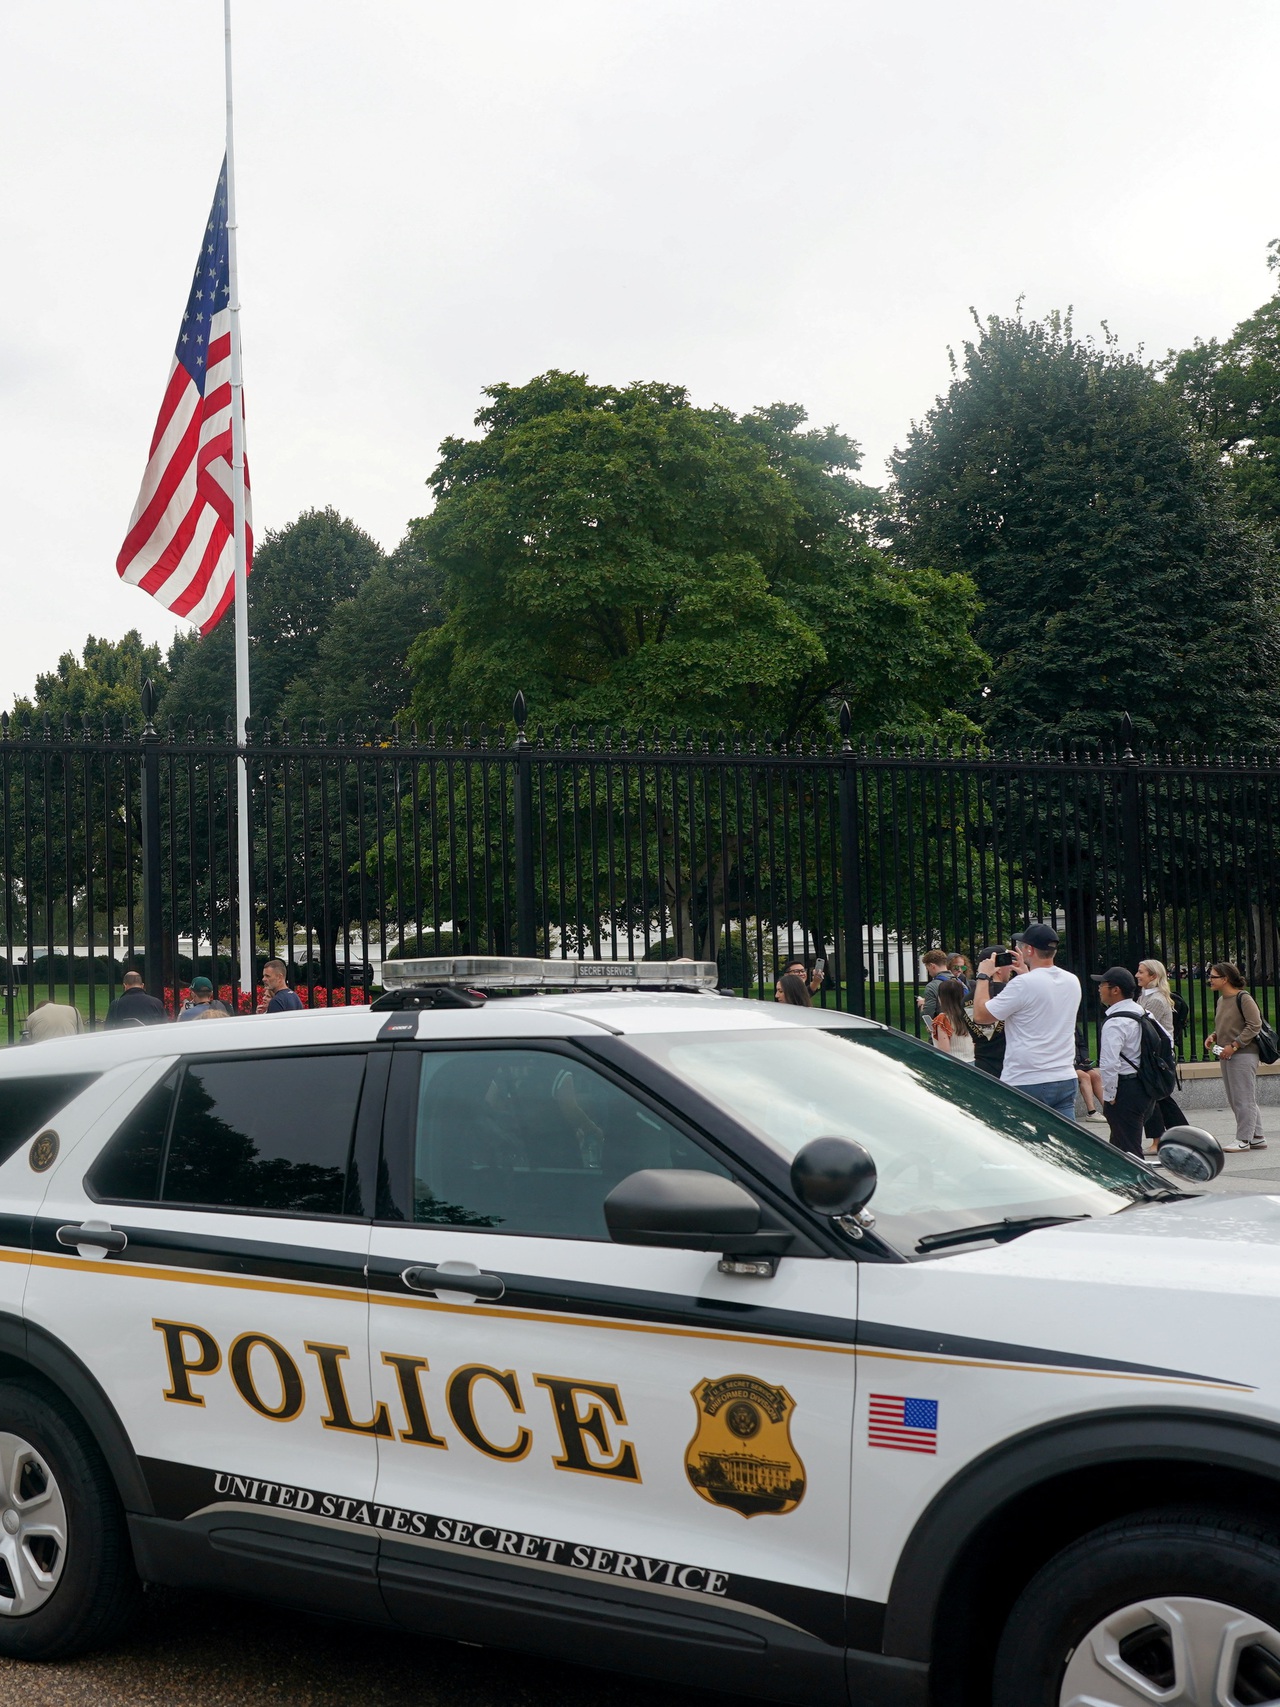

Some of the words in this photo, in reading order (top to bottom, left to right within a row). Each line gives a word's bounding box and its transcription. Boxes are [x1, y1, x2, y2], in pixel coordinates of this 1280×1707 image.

[580, 965, 605, 976] SECRET
[606, 966, 633, 976] SERVICE
[152, 1317, 643, 1485] POLICE
[708, 1390, 749, 1414] UNIFORMED
[749, 1392, 778, 1420] DIVISION
[726, 1381, 750, 1389] SECRET
[750, 1382, 776, 1402] SERVICE
[213, 1472, 315, 1512] UNITED
[319, 1495, 427, 1536] STATES
[433, 1518, 565, 1564] SECRET
[569, 1545, 730, 1597] SERVICE
